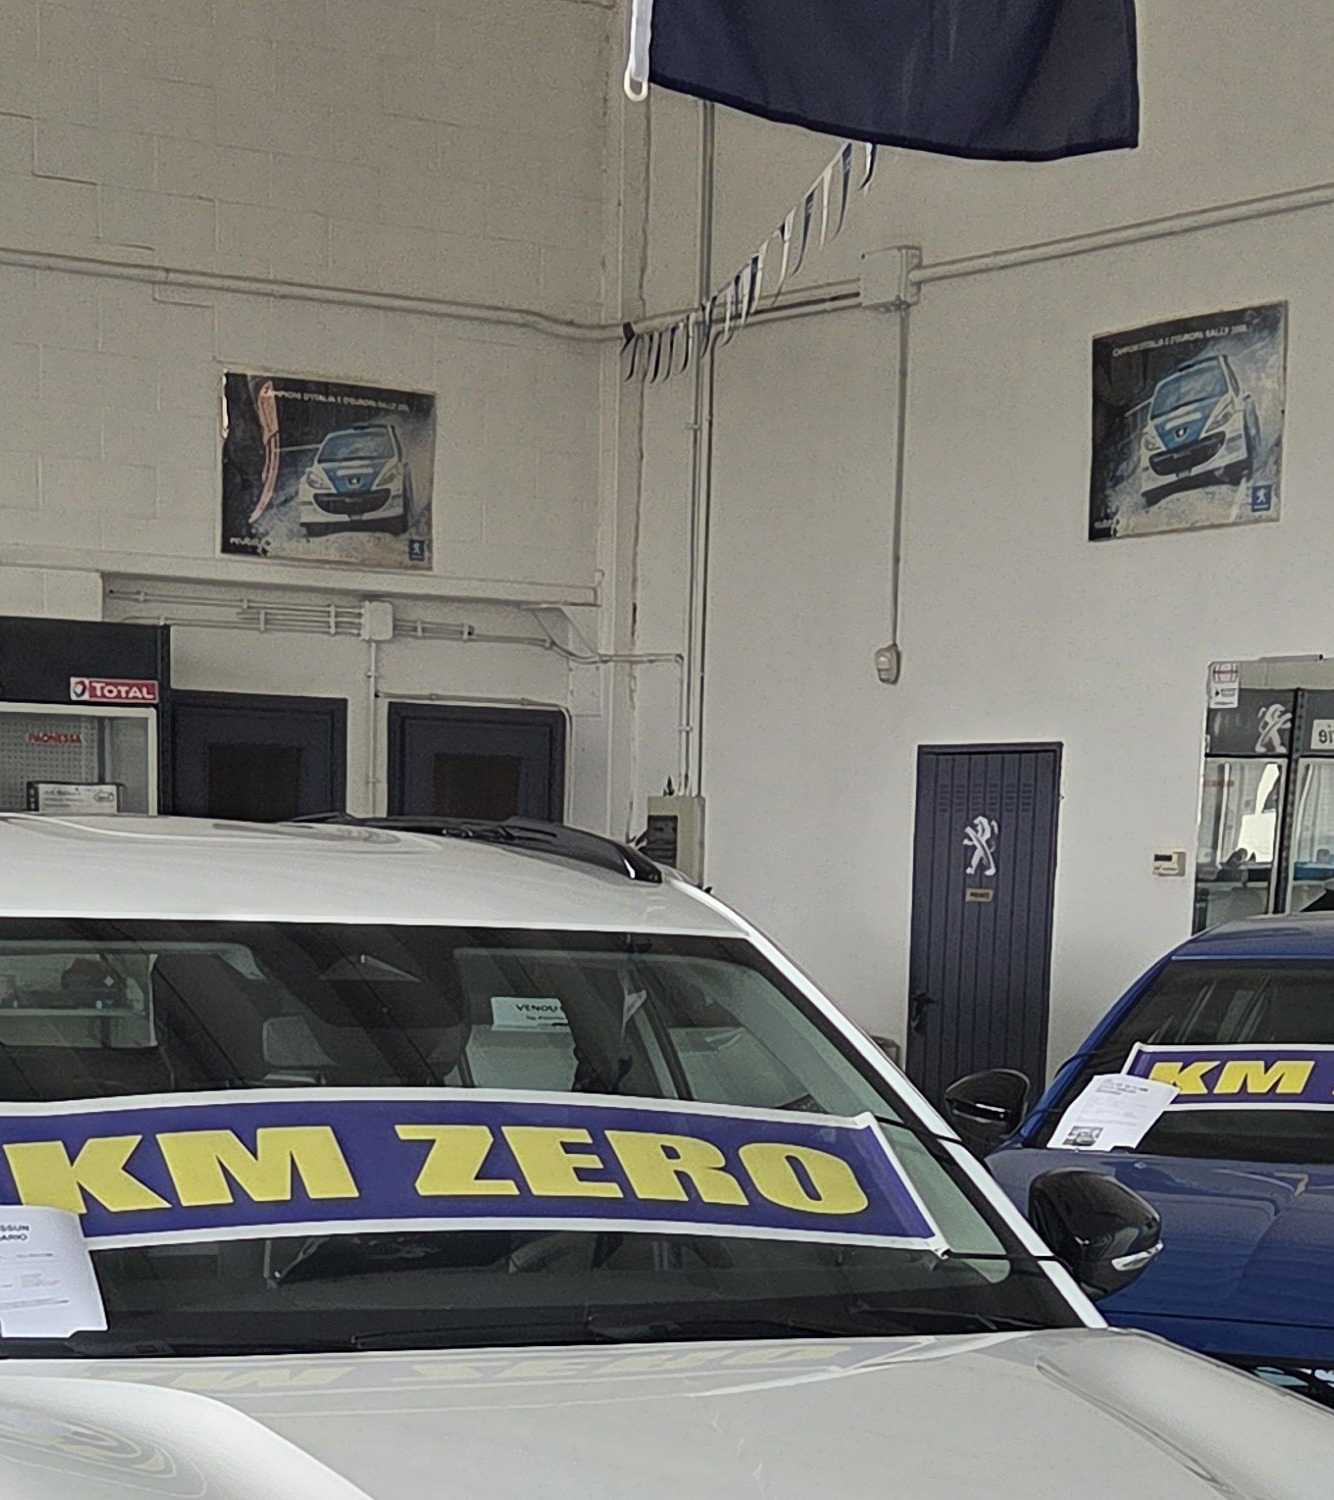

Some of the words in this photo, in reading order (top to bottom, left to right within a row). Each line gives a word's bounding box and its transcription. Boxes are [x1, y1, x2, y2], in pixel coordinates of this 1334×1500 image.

[91, 683, 154, 699] TOTAL
[1146, 1060, 1316, 1096] KM
[2, 1125, 359, 1214] KM
[394, 1124, 869, 1214] ZERO
